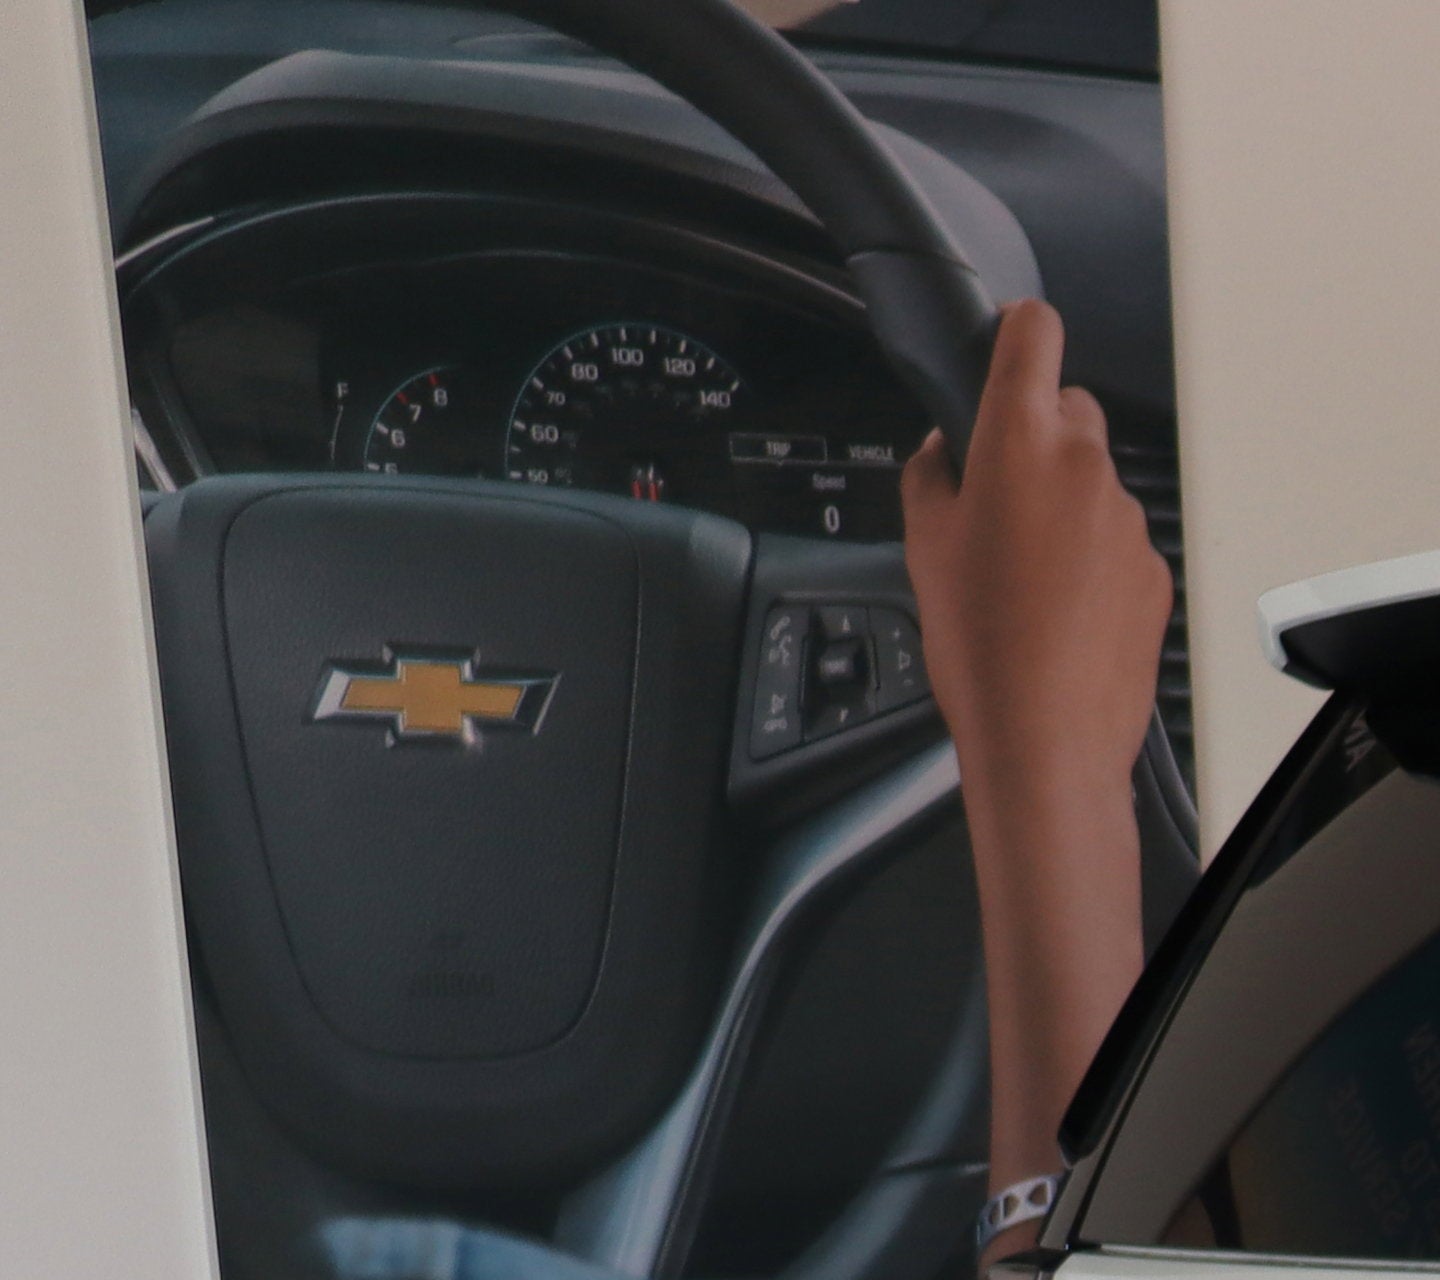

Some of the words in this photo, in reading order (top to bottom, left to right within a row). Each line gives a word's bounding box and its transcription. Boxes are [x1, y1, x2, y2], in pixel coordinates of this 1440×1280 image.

[612, 348, 644, 366] 100
[571, 362, 599, 381] 80
[664, 357, 696, 376] 120
[433, 389, 448, 406] 8
[701, 390, 731, 408] 140
[409, 403, 422, 422] 7
[390, 429, 406, 447] 6
[531, 424, 559, 443] 60
